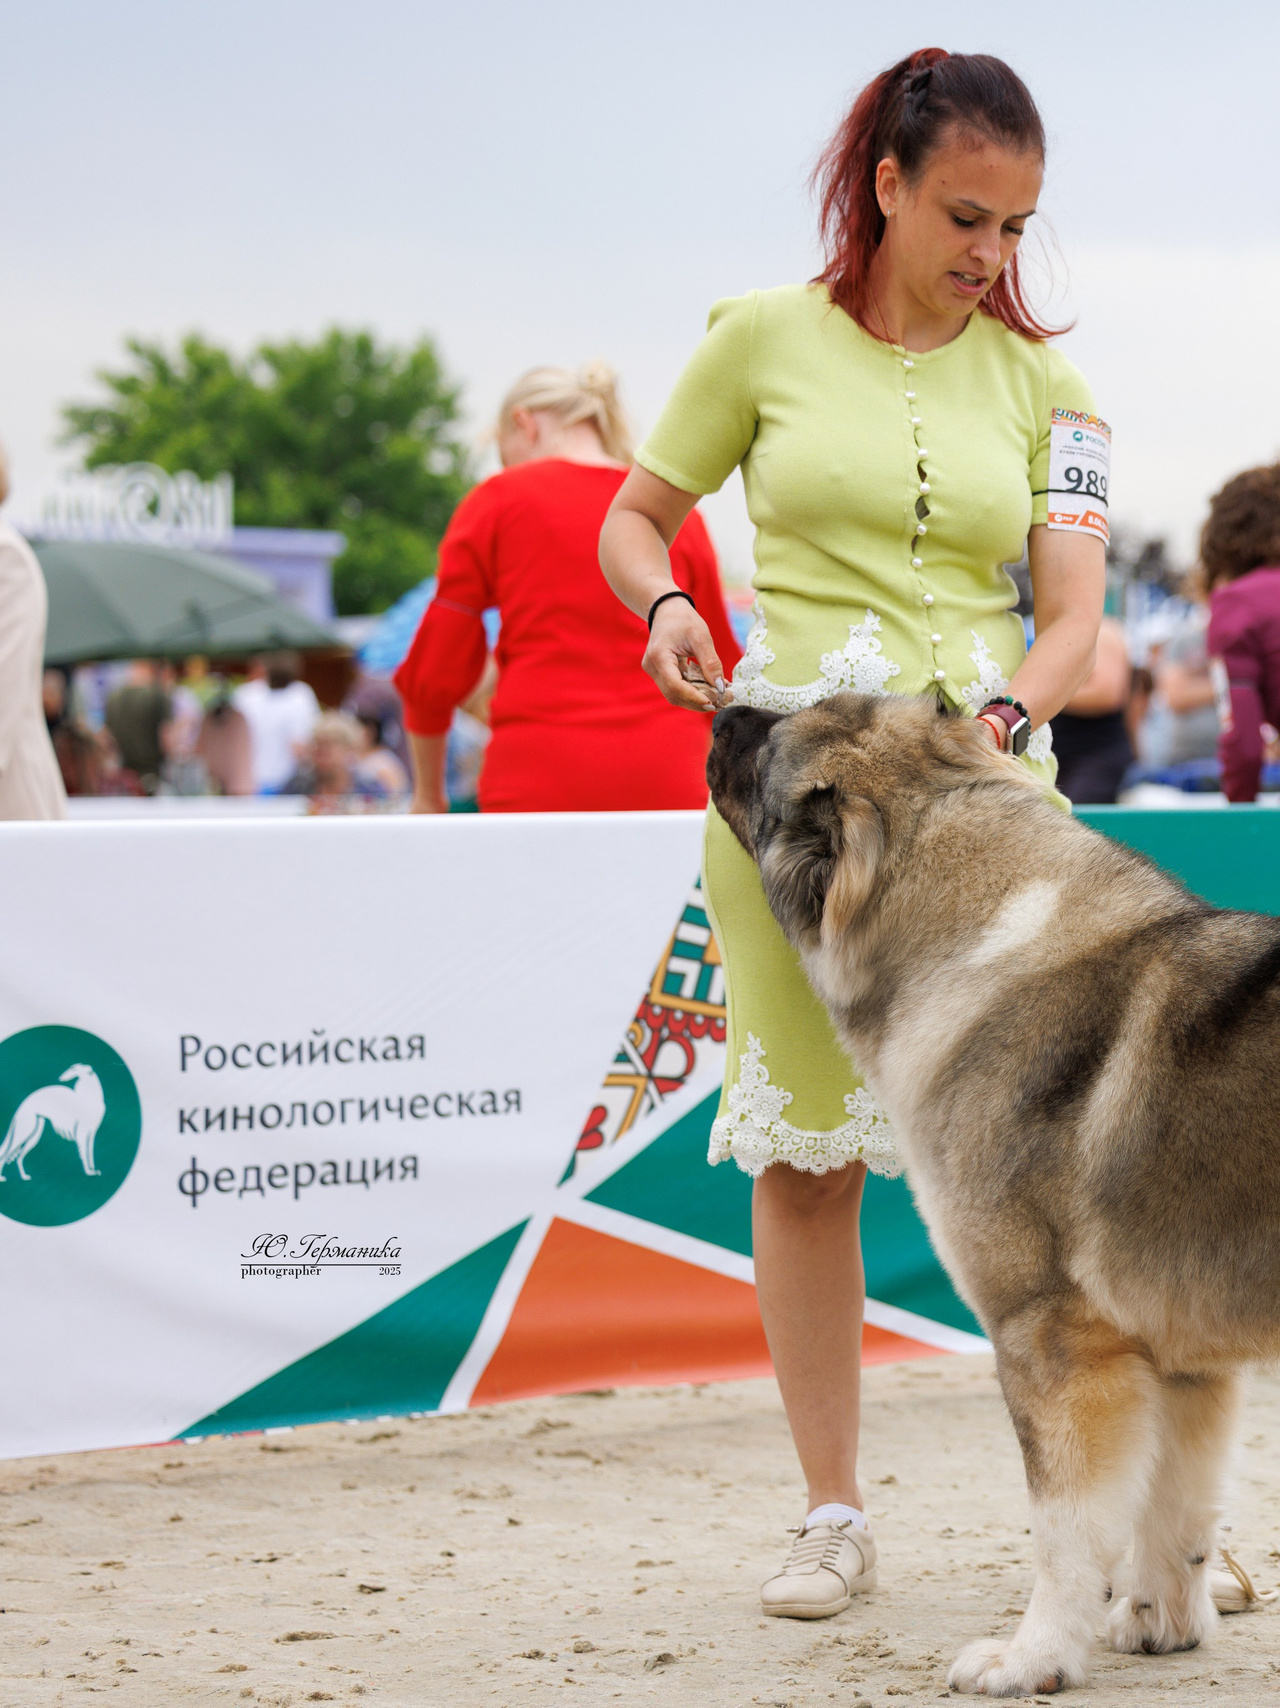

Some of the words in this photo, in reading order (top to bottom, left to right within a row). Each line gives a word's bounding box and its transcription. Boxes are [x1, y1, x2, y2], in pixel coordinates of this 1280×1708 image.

[1064, 467, 1107, 498] 989
[179, 1029, 426, 1072] Российская
[178, 1088, 522, 1134] кинологическая
[178, 1154, 419, 1208] федерация
